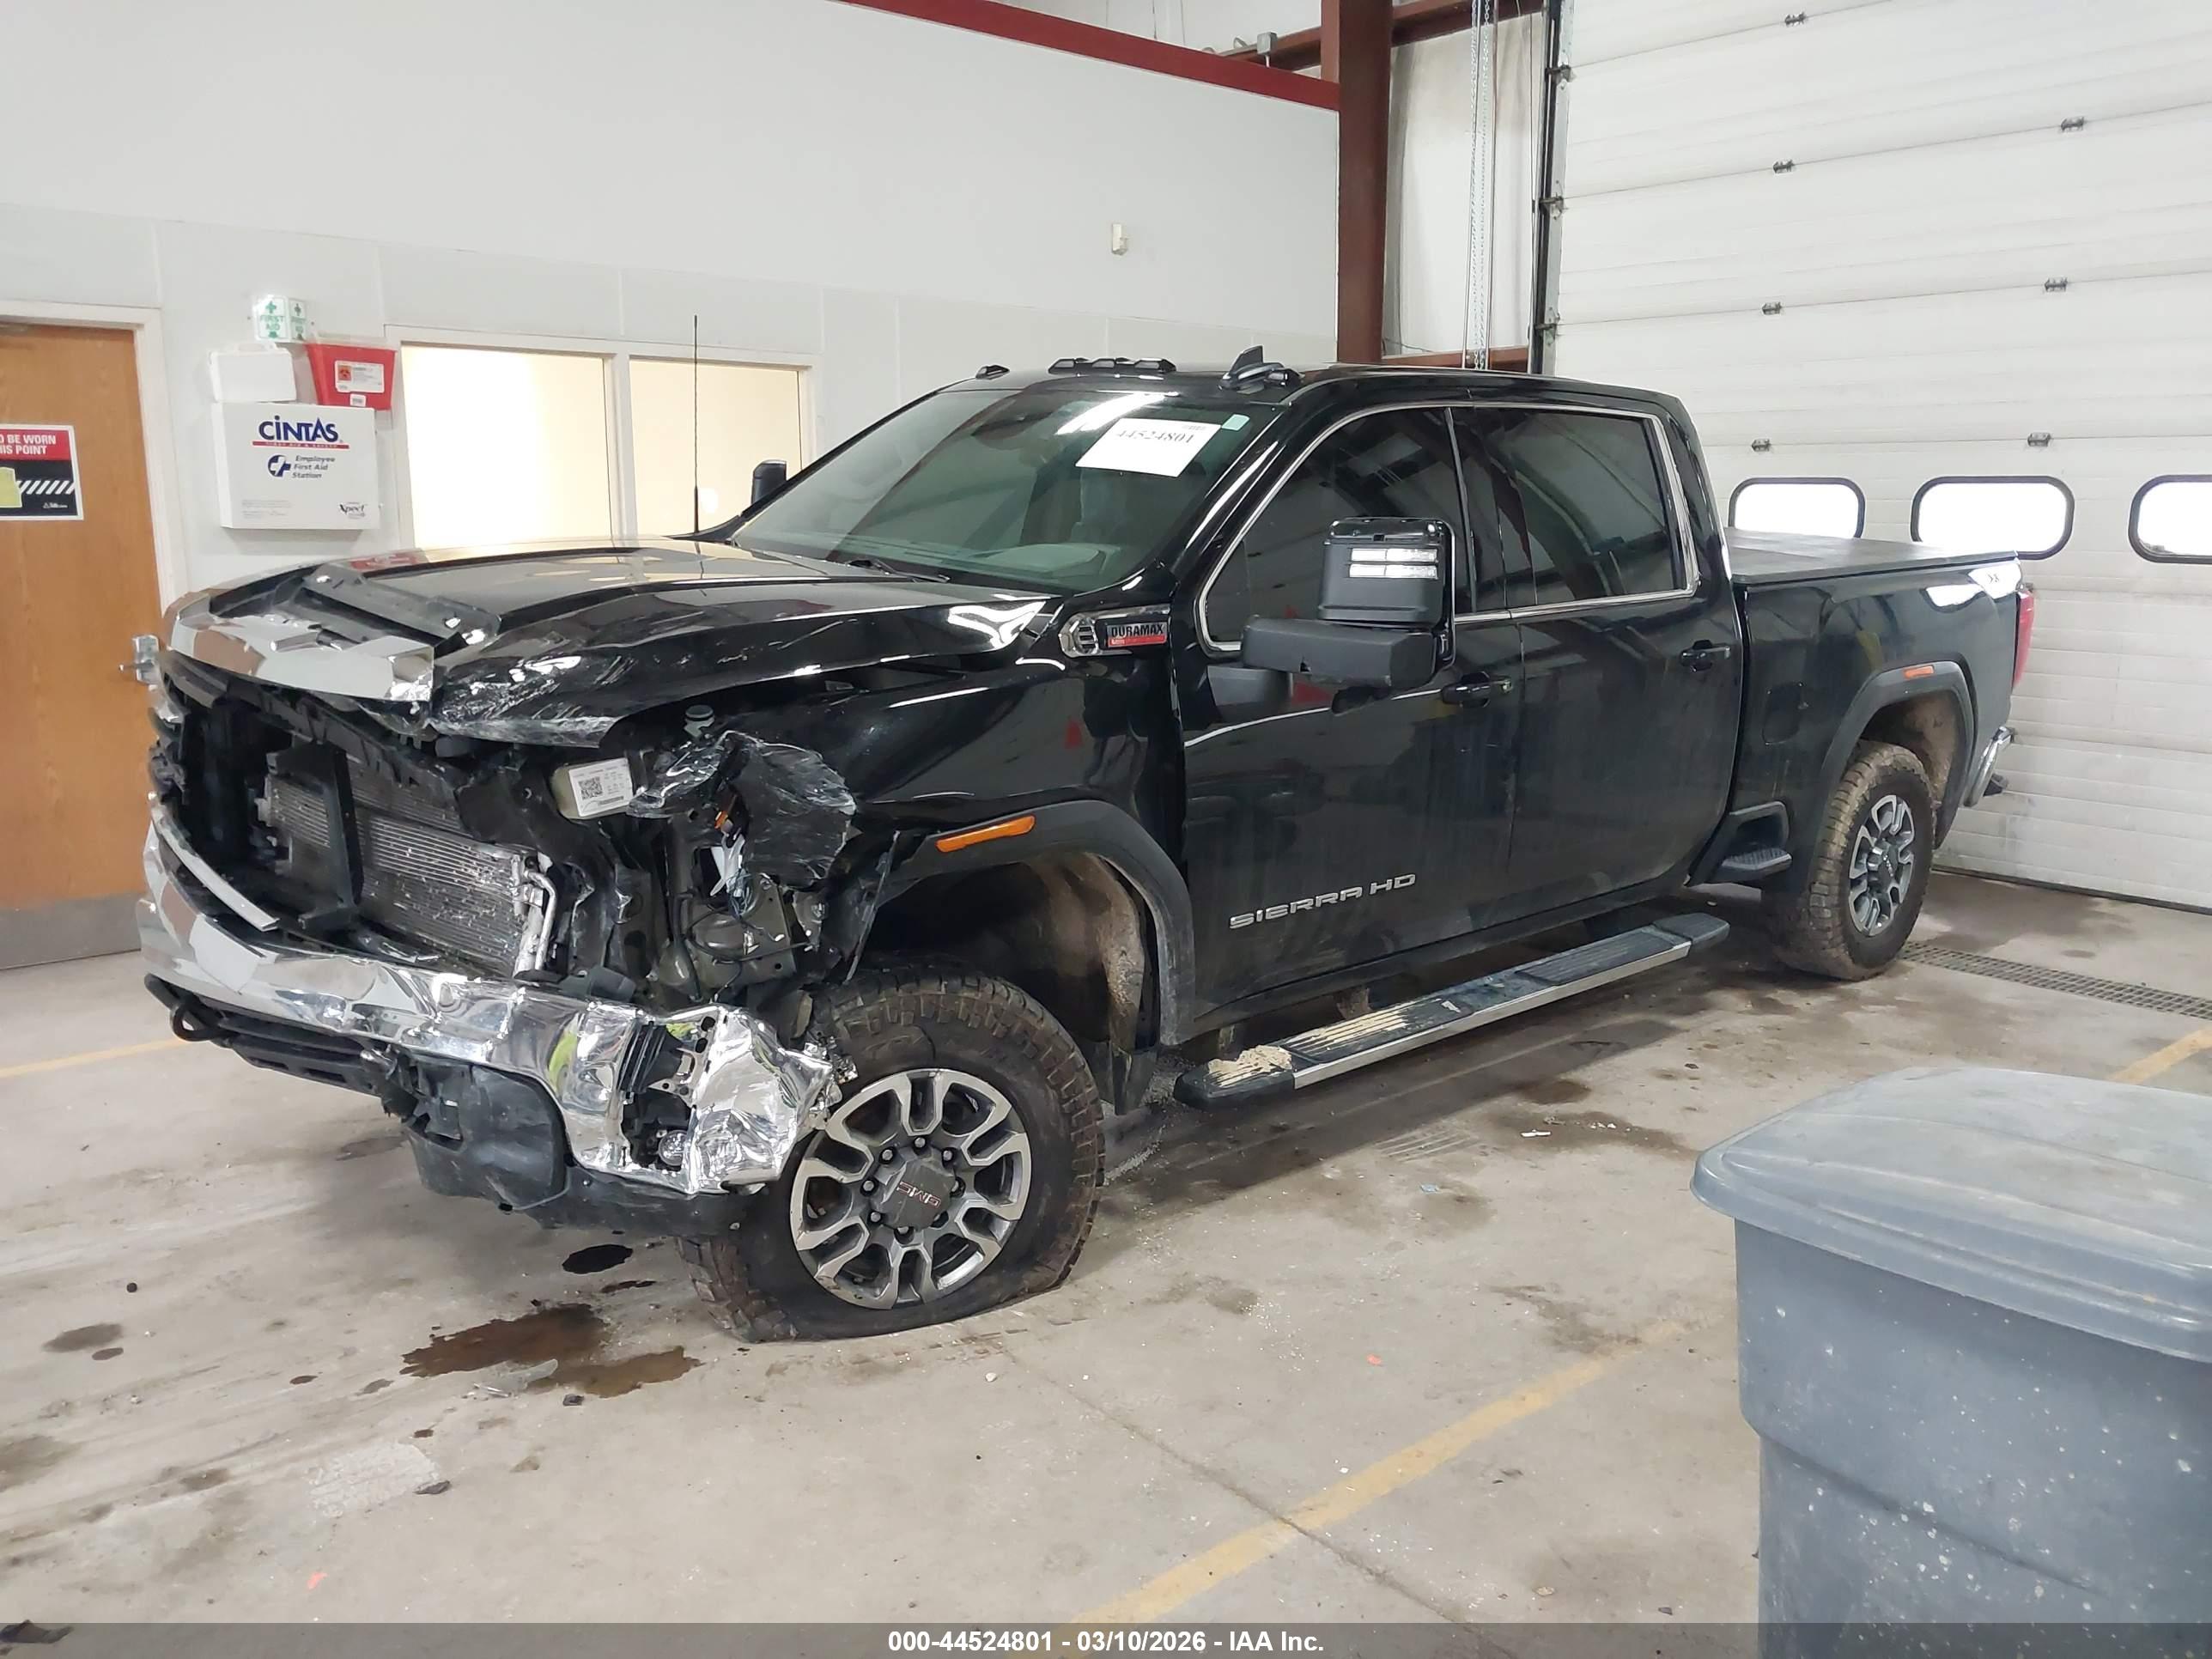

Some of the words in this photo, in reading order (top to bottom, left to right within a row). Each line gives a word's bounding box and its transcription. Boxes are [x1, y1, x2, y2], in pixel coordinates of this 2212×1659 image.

[7, 434, 21, 444] BE
[22, 434, 57, 445] WORN
[1116, 429, 1194, 443] 44524801
[15, 445, 47, 455] POINT
[295, 455, 336, 465] Employee
[1111, 623, 1164, 638] DURAMAX
[1230, 886, 1363, 929] SIERRA
[1370, 873, 1416, 895] HD
[896, 1181, 941, 1209] GMC
